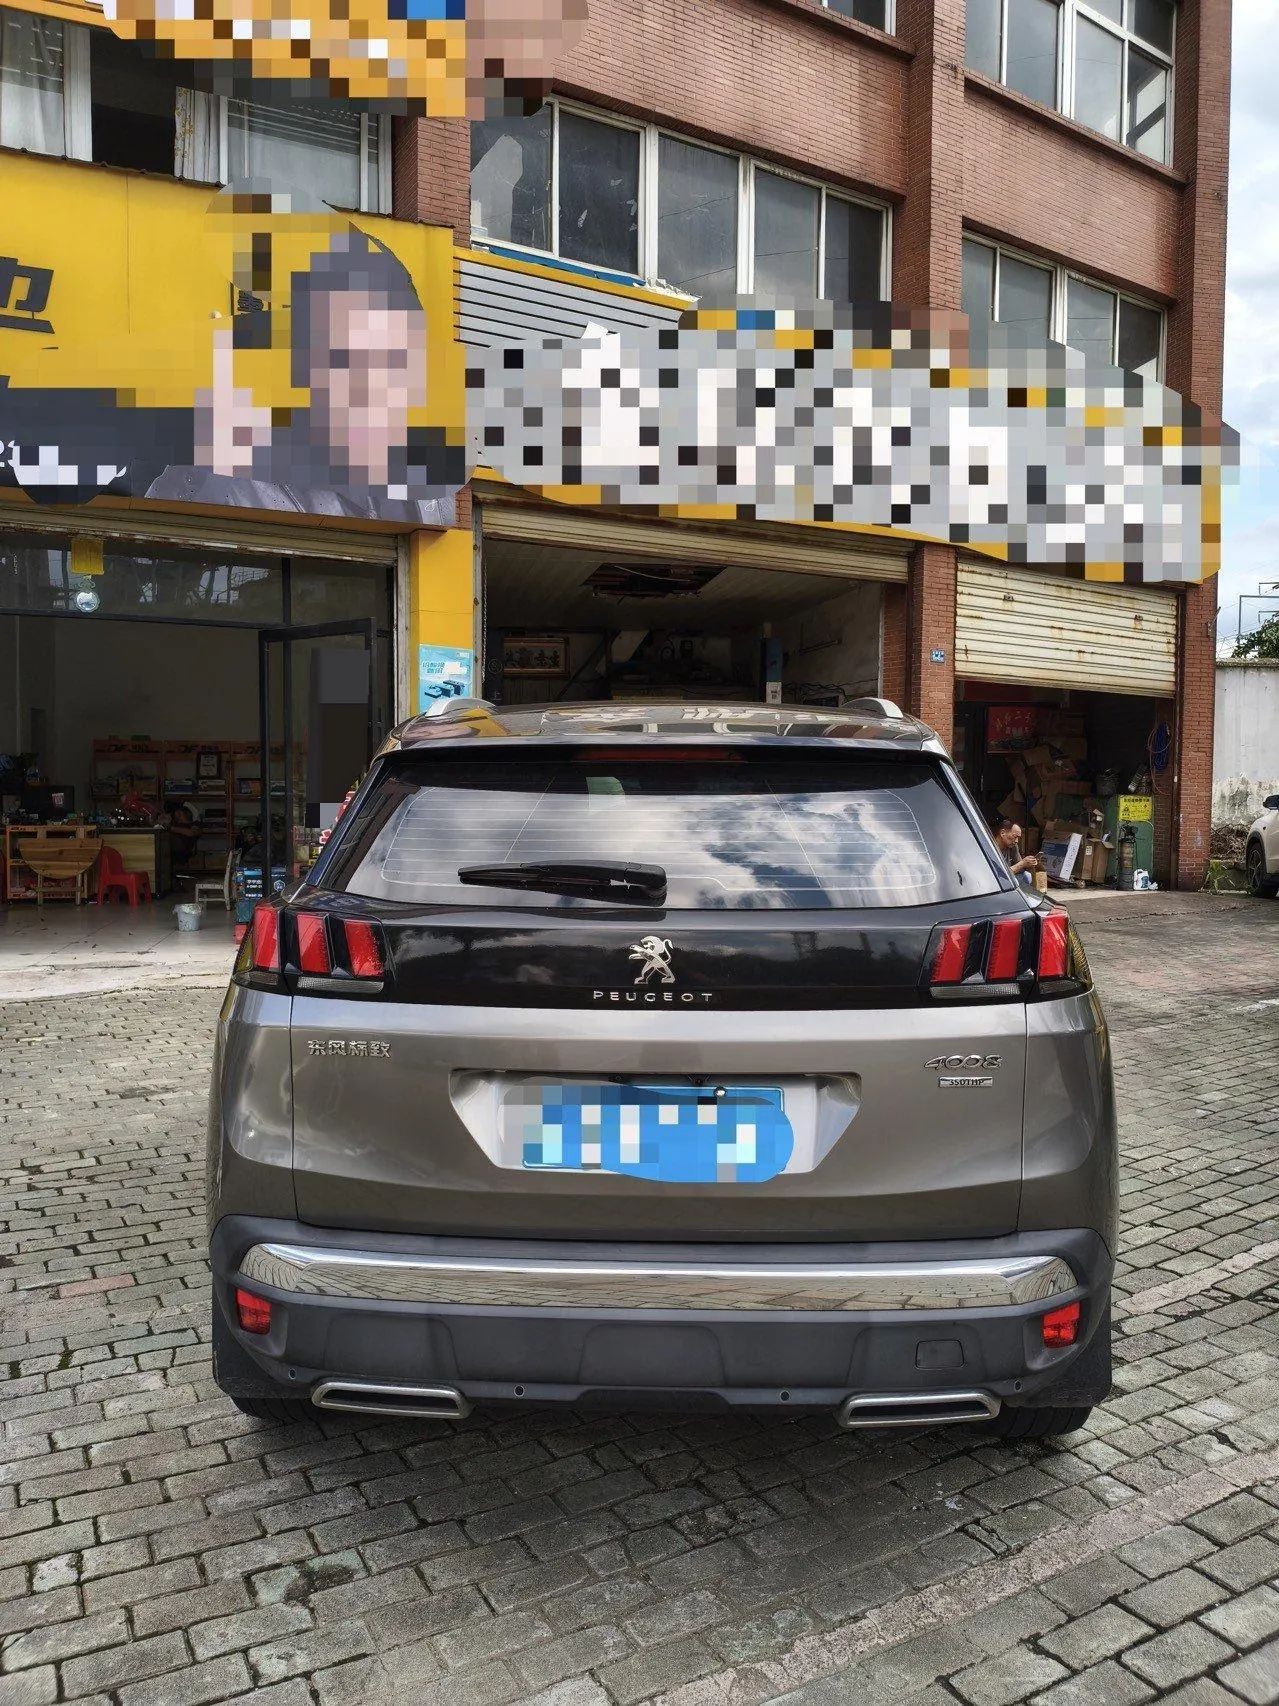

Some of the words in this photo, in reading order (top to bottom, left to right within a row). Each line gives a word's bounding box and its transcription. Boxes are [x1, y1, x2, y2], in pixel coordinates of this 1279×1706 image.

[593, 990, 713, 1002] PEUGEOT
[307, 1040, 391, 1058] 东风标致
[924, 1054, 1002, 1070] 4008
